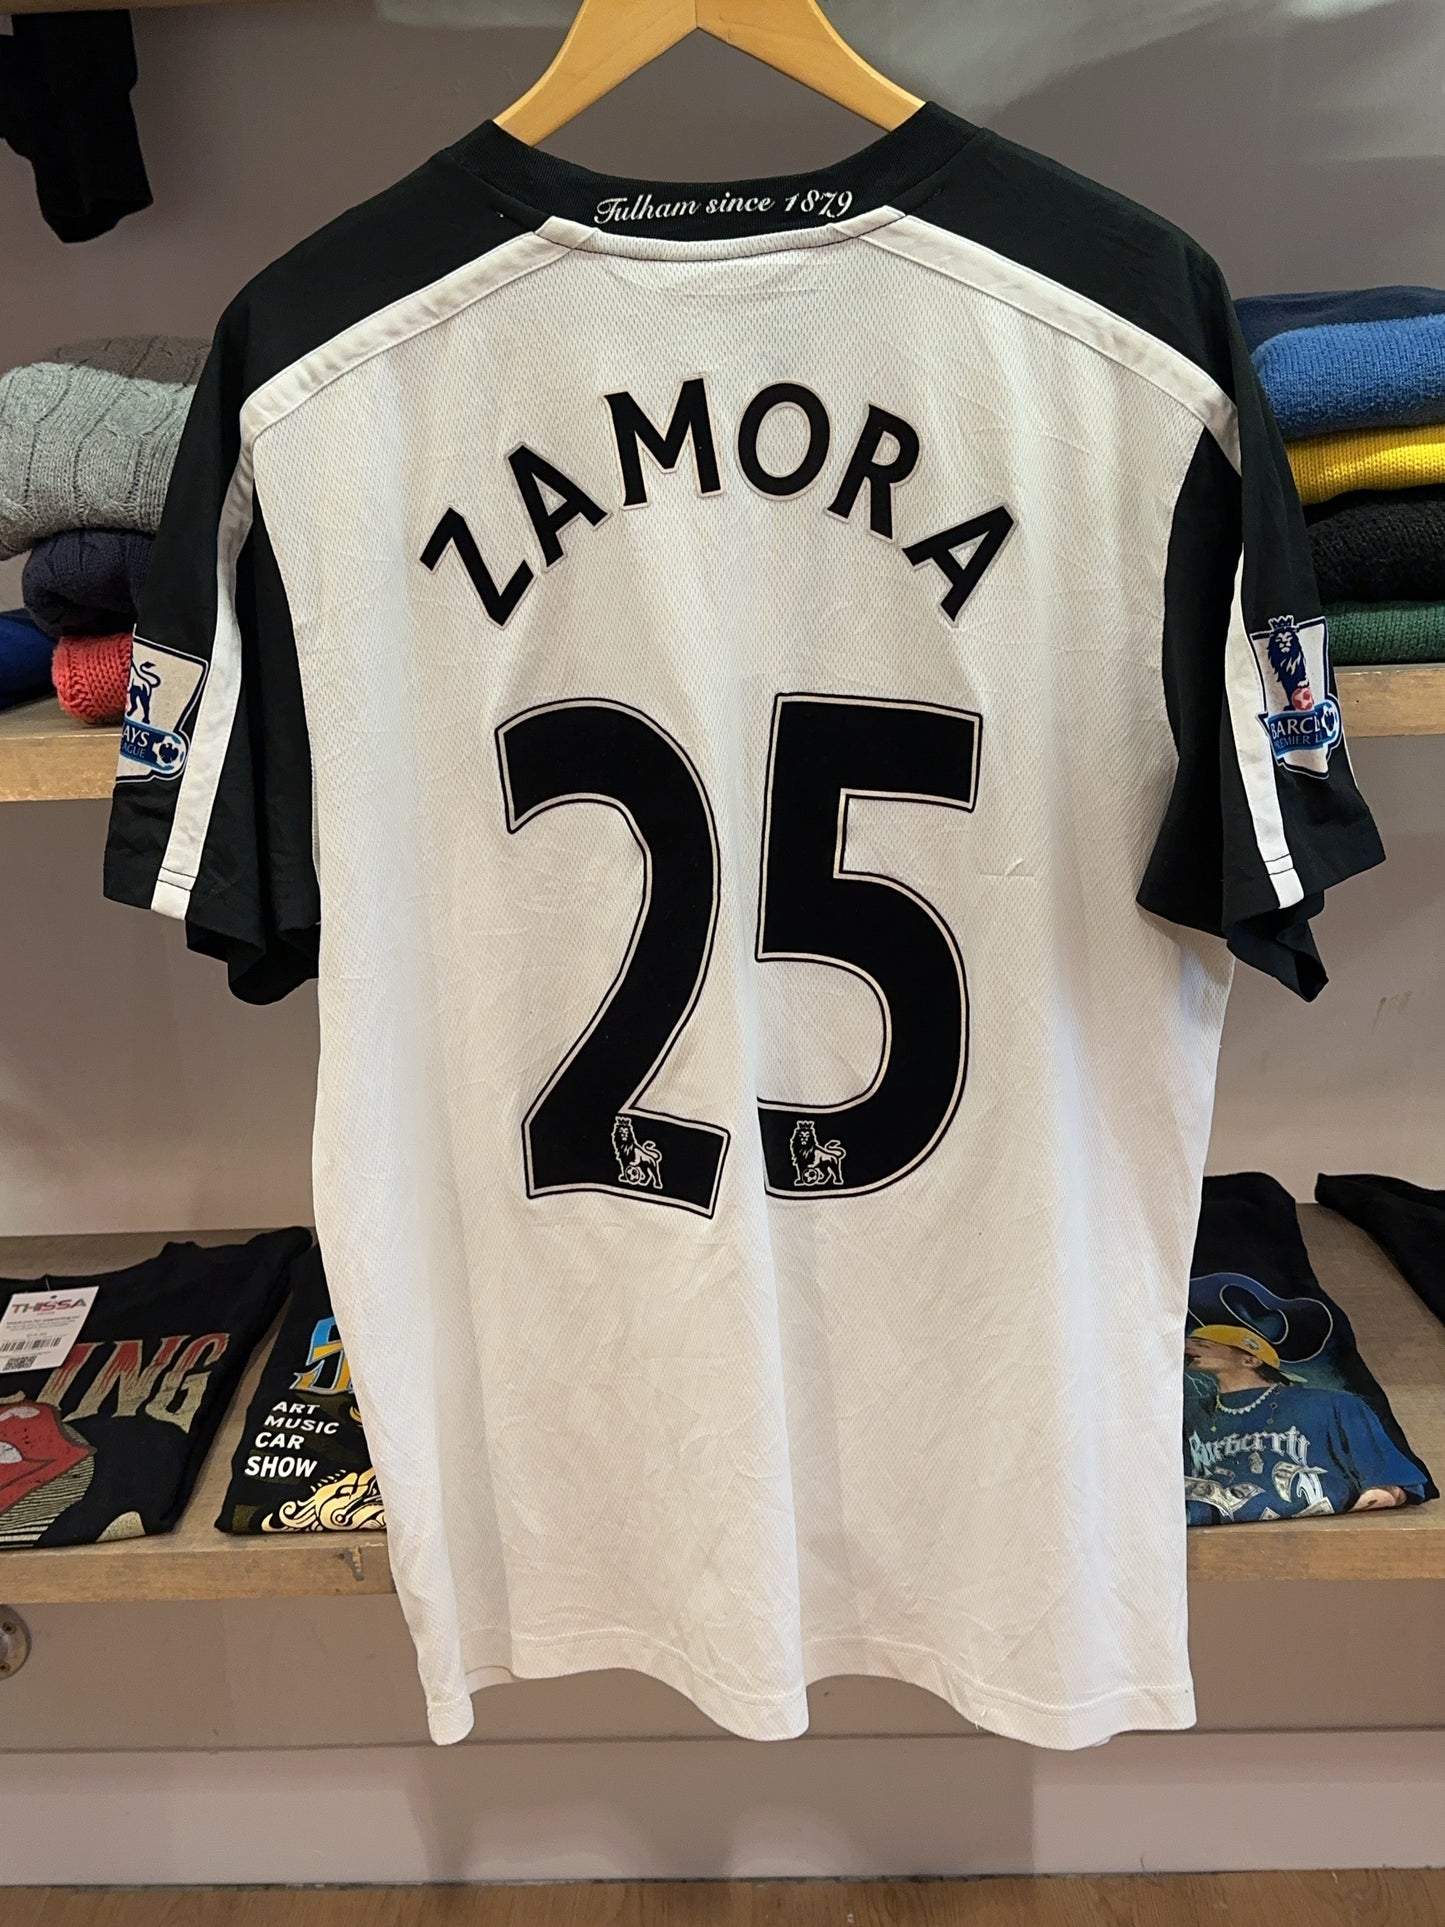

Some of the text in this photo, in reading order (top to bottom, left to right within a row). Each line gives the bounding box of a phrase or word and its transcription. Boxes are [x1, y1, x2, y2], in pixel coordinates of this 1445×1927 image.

[594, 189, 853, 224] Fulham since 1879
[418, 377, 1016, 627] ZAMORA
[494, 691, 983, 1220] 25
[12, 1298, 87, 1313] THISSA
[0, 1333, 231, 1434] ING
[272, 1401, 320, 1414] ART
[264, 1415, 340, 1434] MUSIC
[255, 1432, 305, 1450] CAR
[244, 1456, 318, 1478] SHOW
